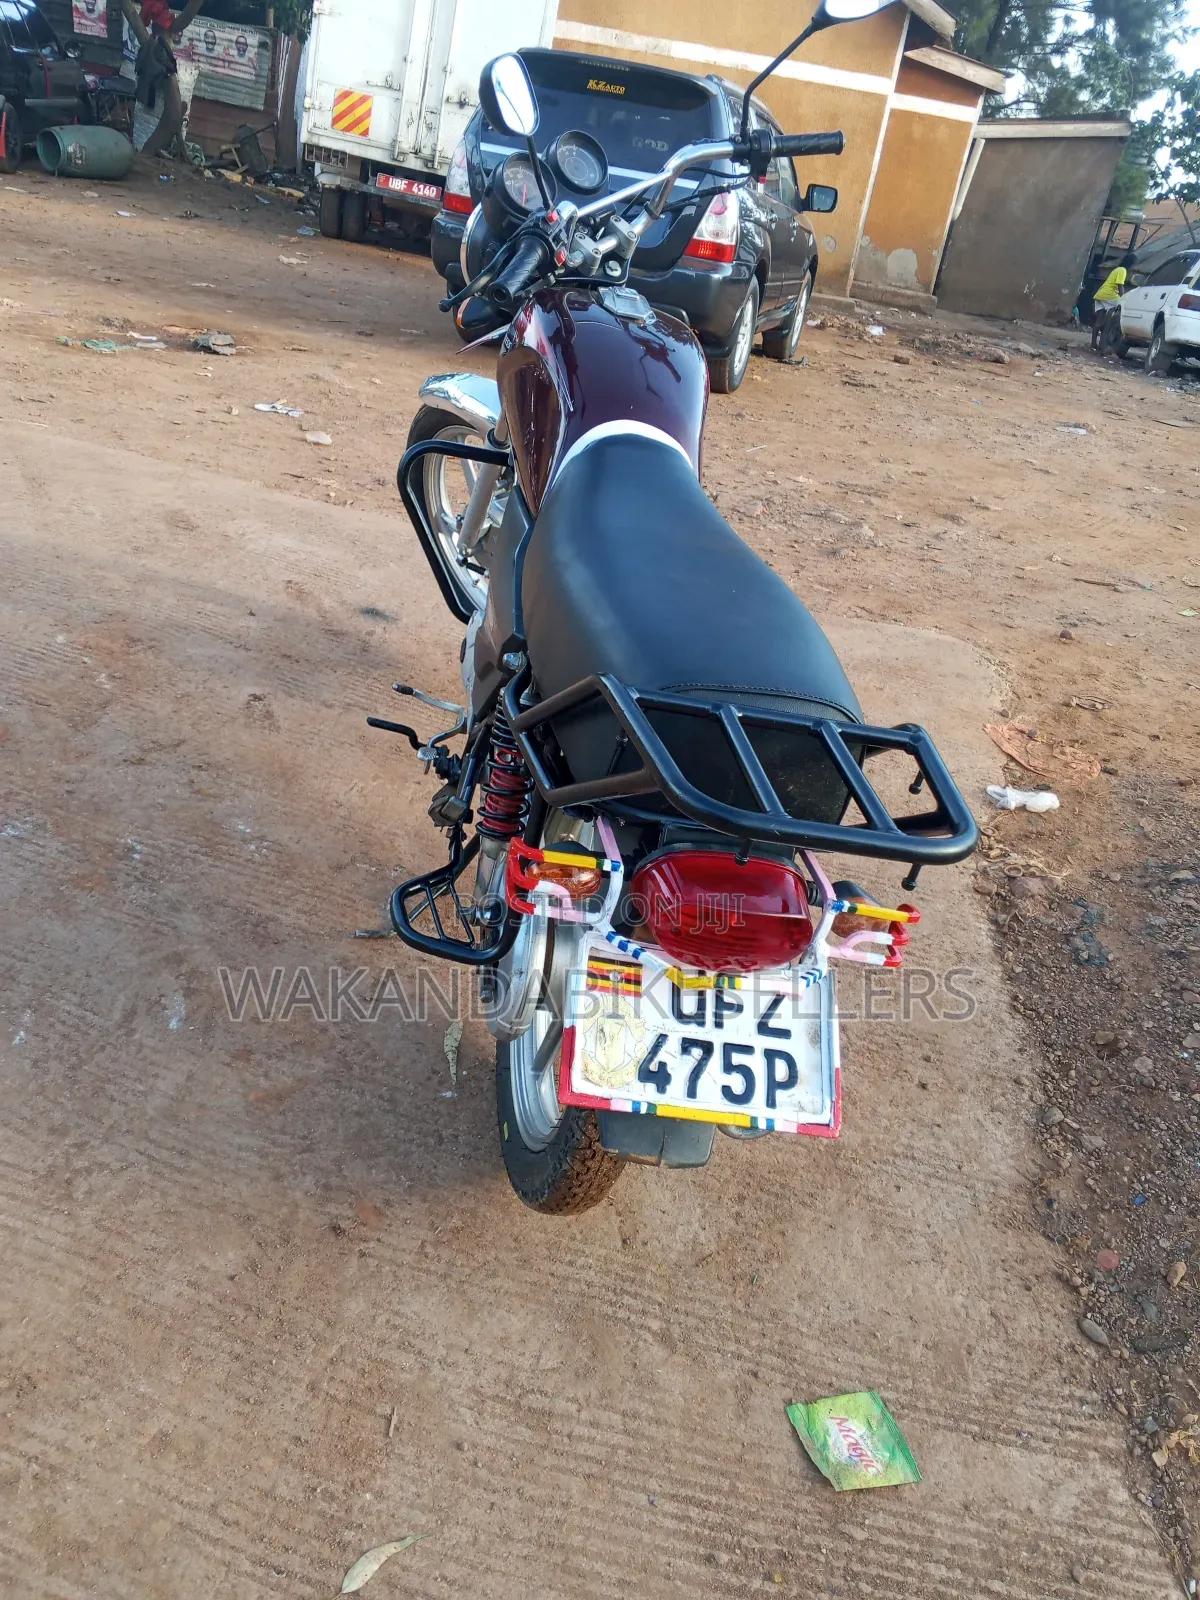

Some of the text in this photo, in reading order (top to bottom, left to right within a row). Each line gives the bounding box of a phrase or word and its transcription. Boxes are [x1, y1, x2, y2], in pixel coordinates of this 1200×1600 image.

[388, 176, 437, 198] UBF 4140
[637, 1033, 799, 1110] 475P
